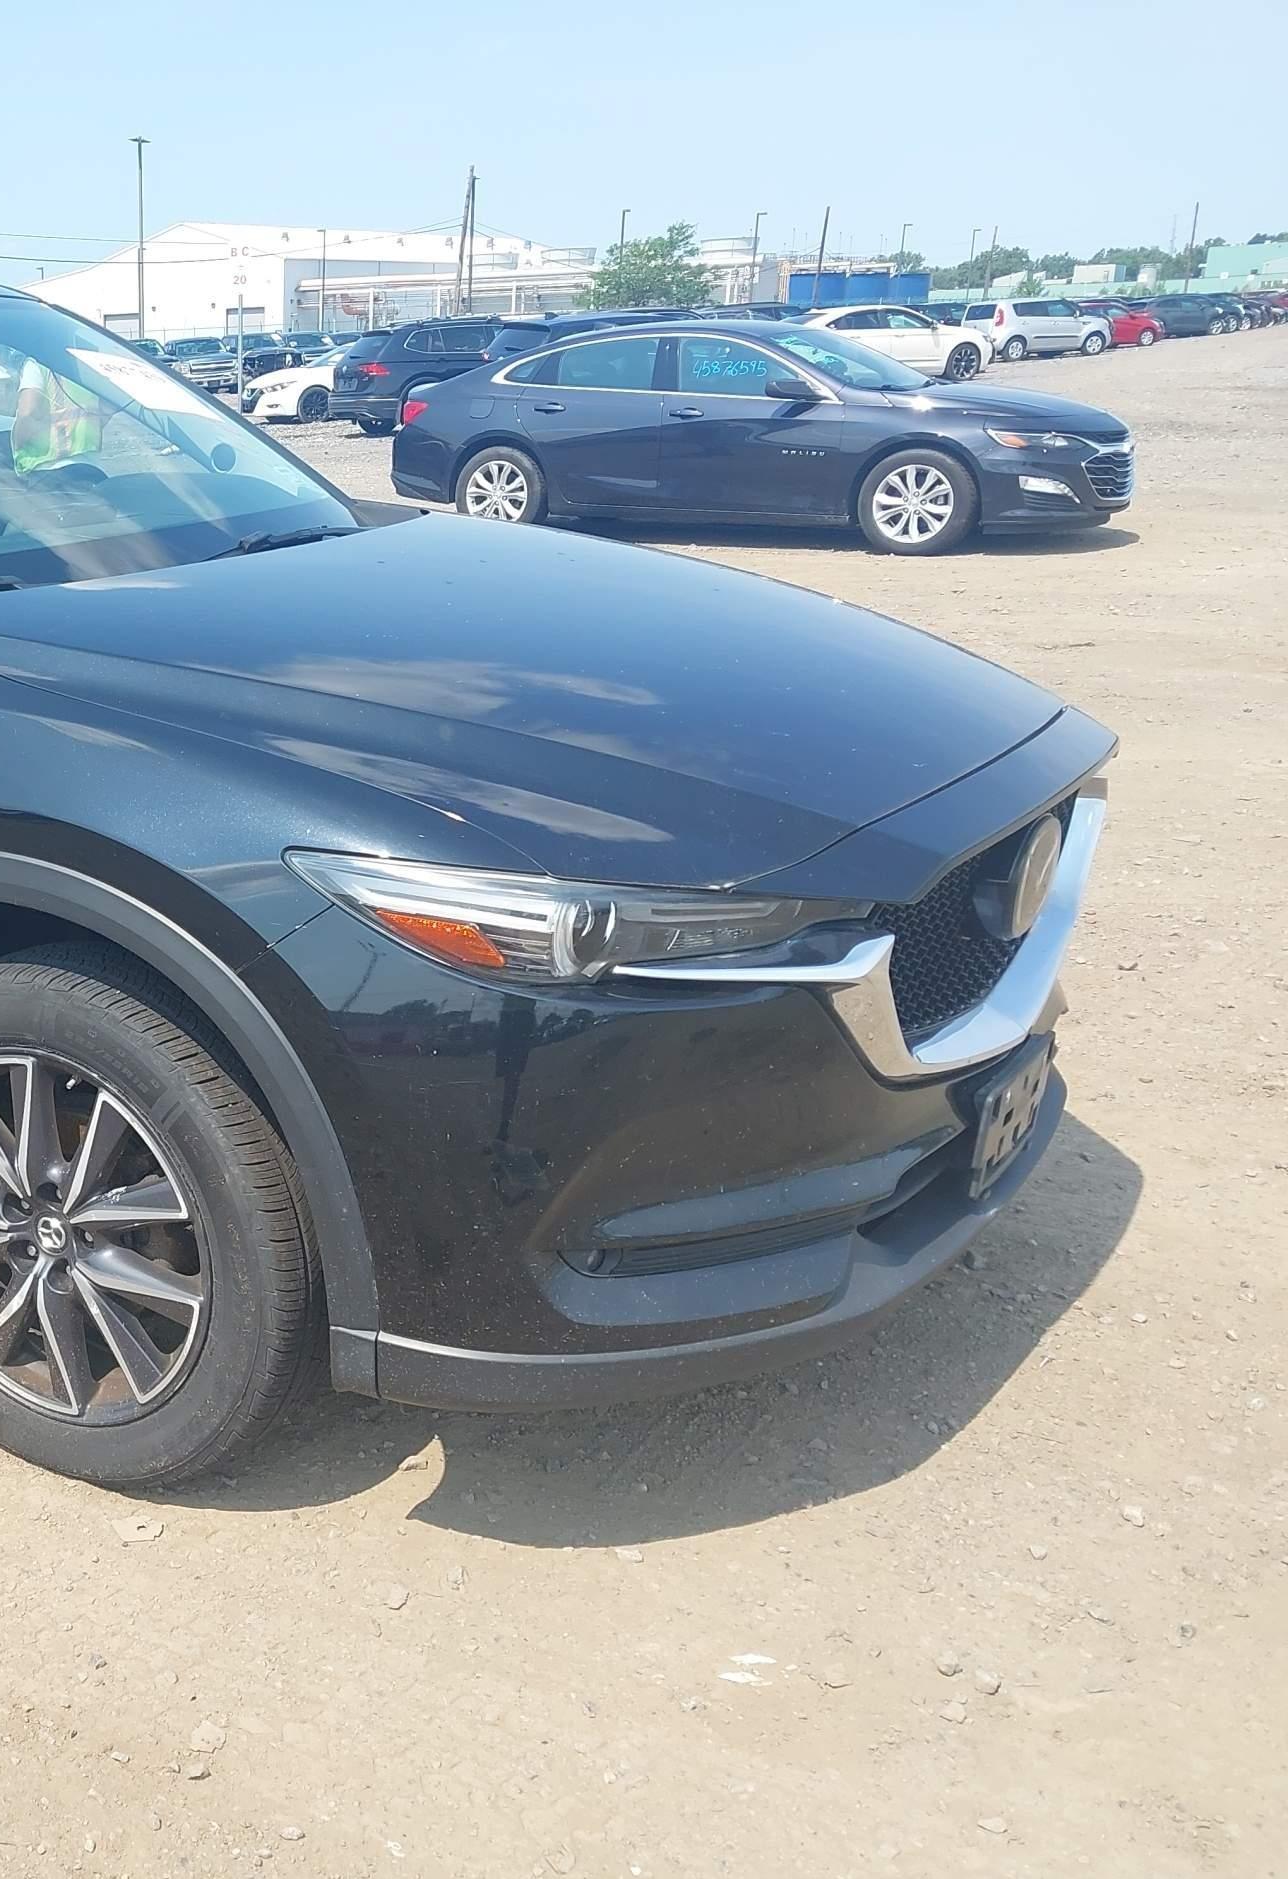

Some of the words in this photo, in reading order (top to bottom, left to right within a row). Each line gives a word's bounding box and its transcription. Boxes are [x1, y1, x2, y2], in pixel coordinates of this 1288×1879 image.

[230, 247, 238, 257] B
[241, 246, 250, 257] C
[232, 274, 248, 285] 20
